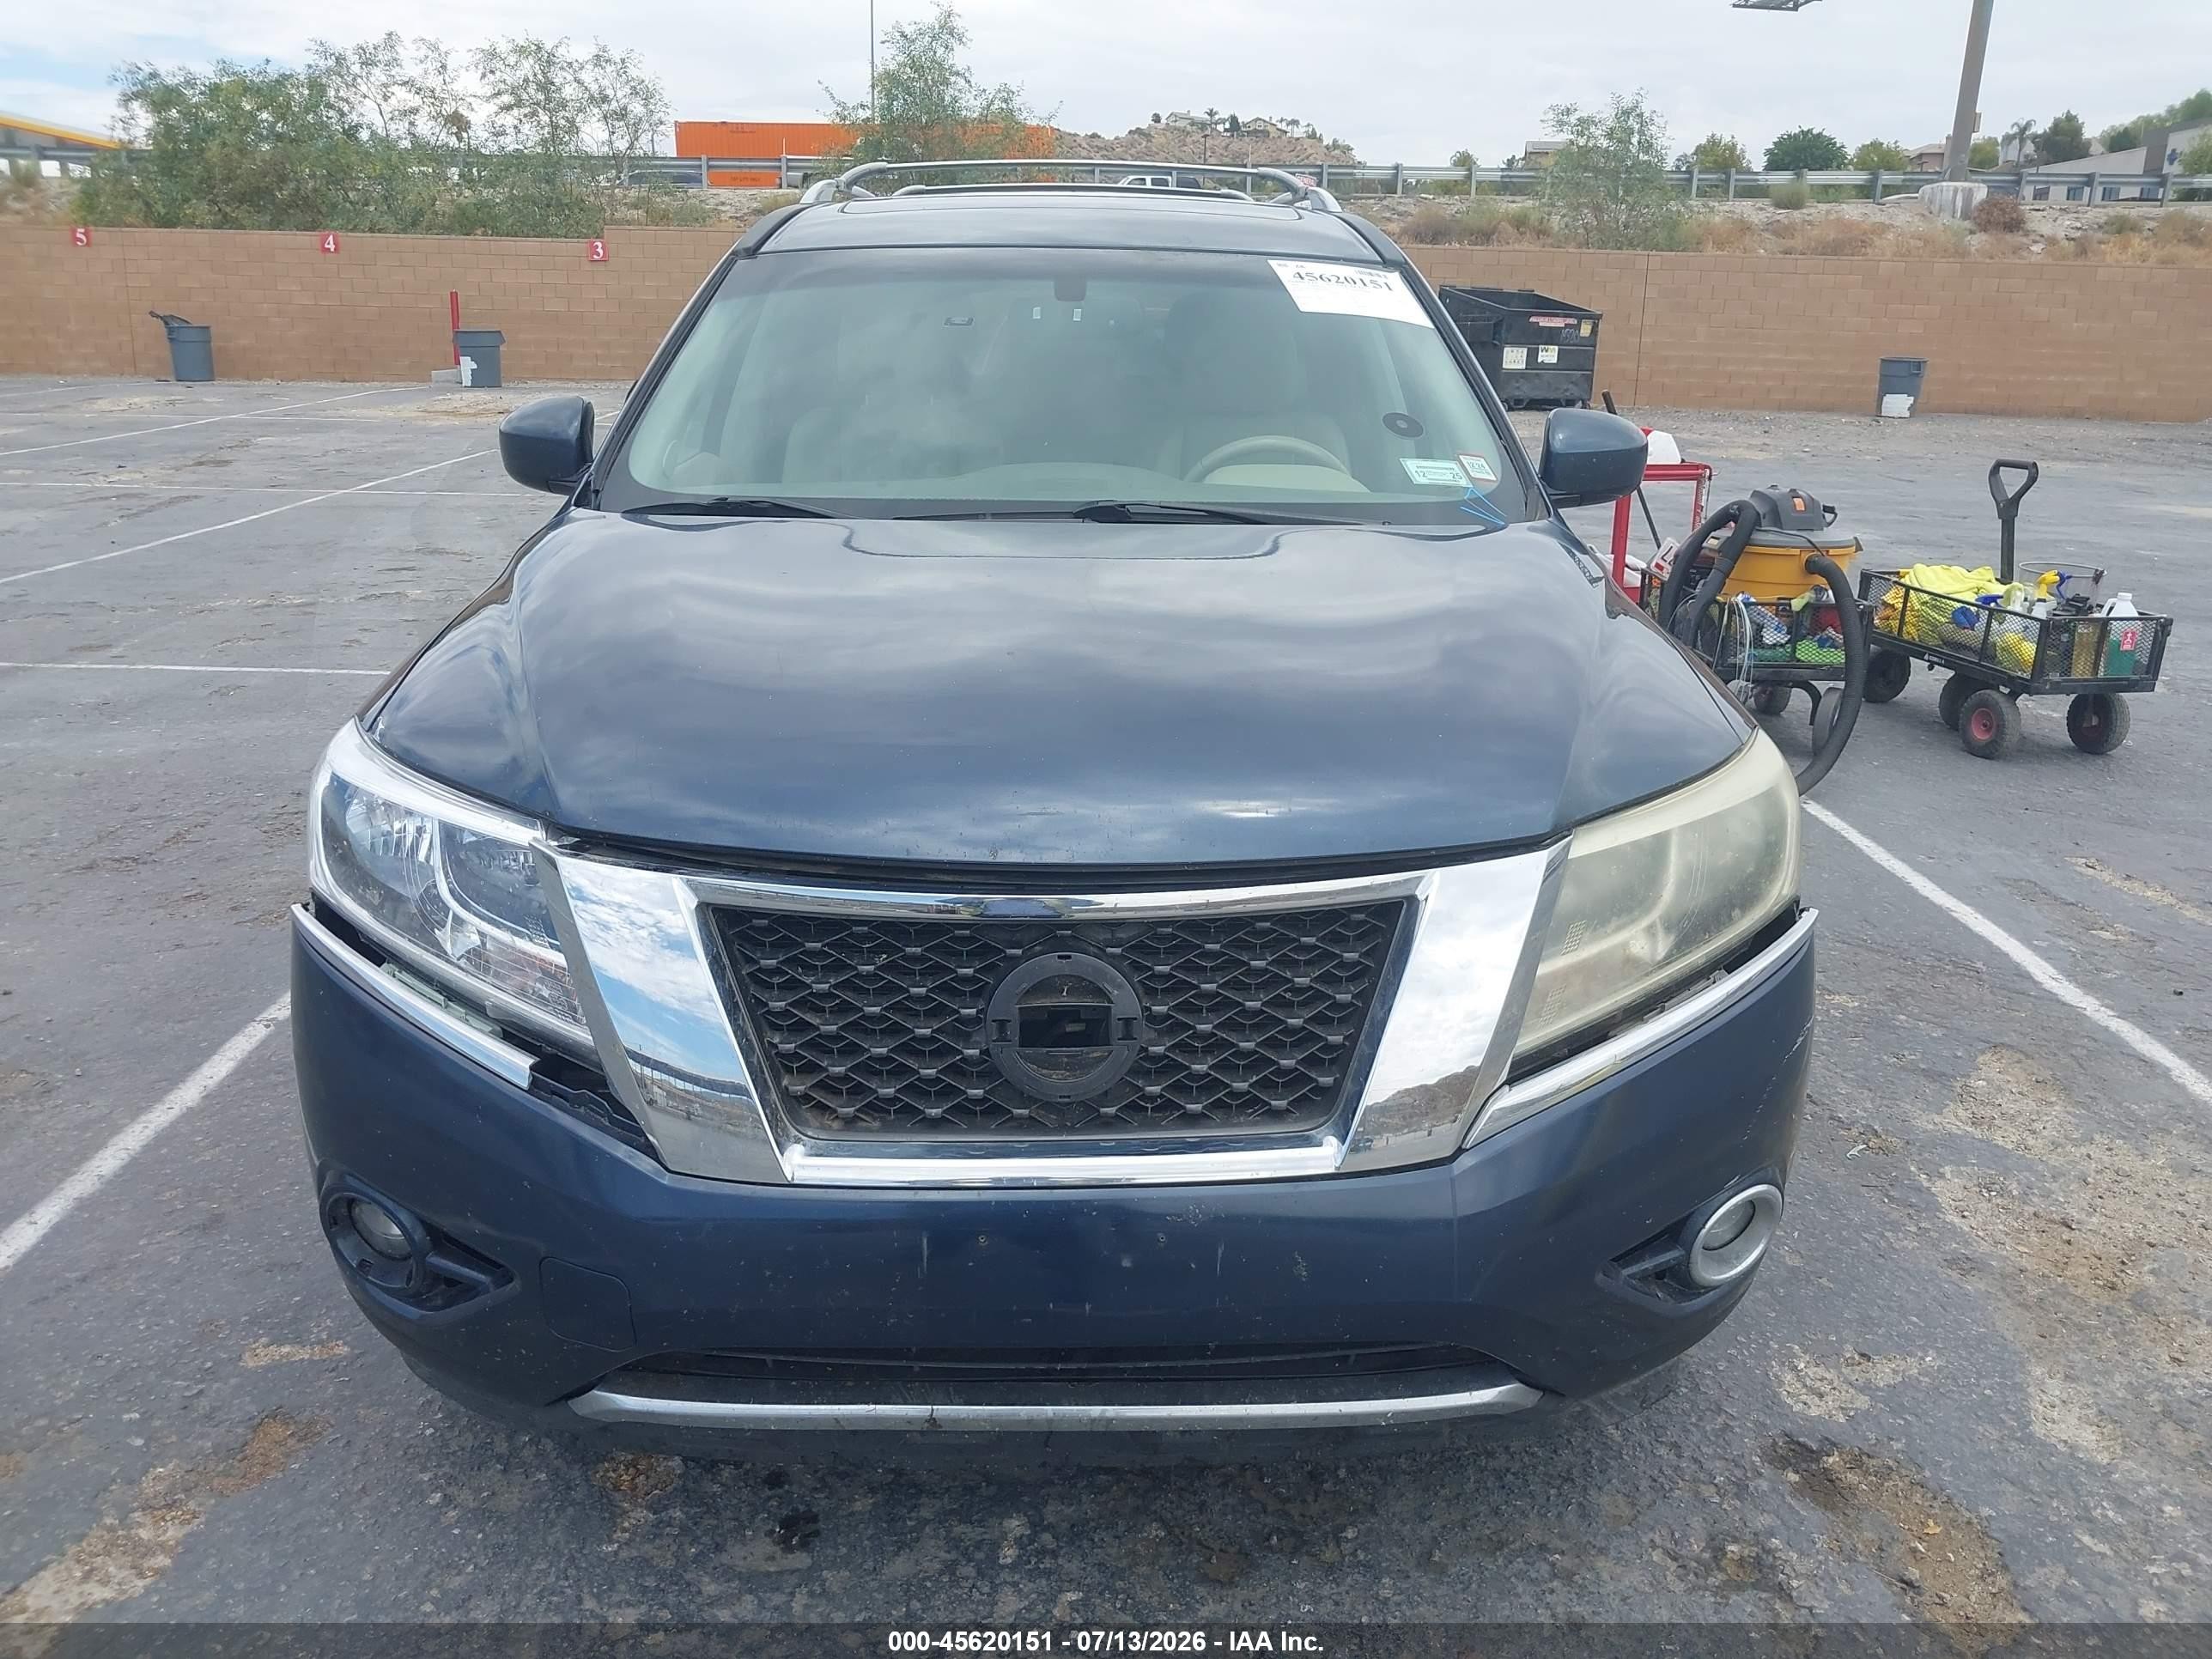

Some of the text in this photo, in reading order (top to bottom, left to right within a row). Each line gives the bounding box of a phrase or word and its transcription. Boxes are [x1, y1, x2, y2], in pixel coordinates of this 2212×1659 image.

[76, 228, 88, 246] 5
[324, 234, 336, 252] 4
[592, 240, 604, 259] 3
[1292, 270, 1394, 292] 45620151
[1414, 470, 1429, 479] 12
[1449, 472, 1463, 481] 25
